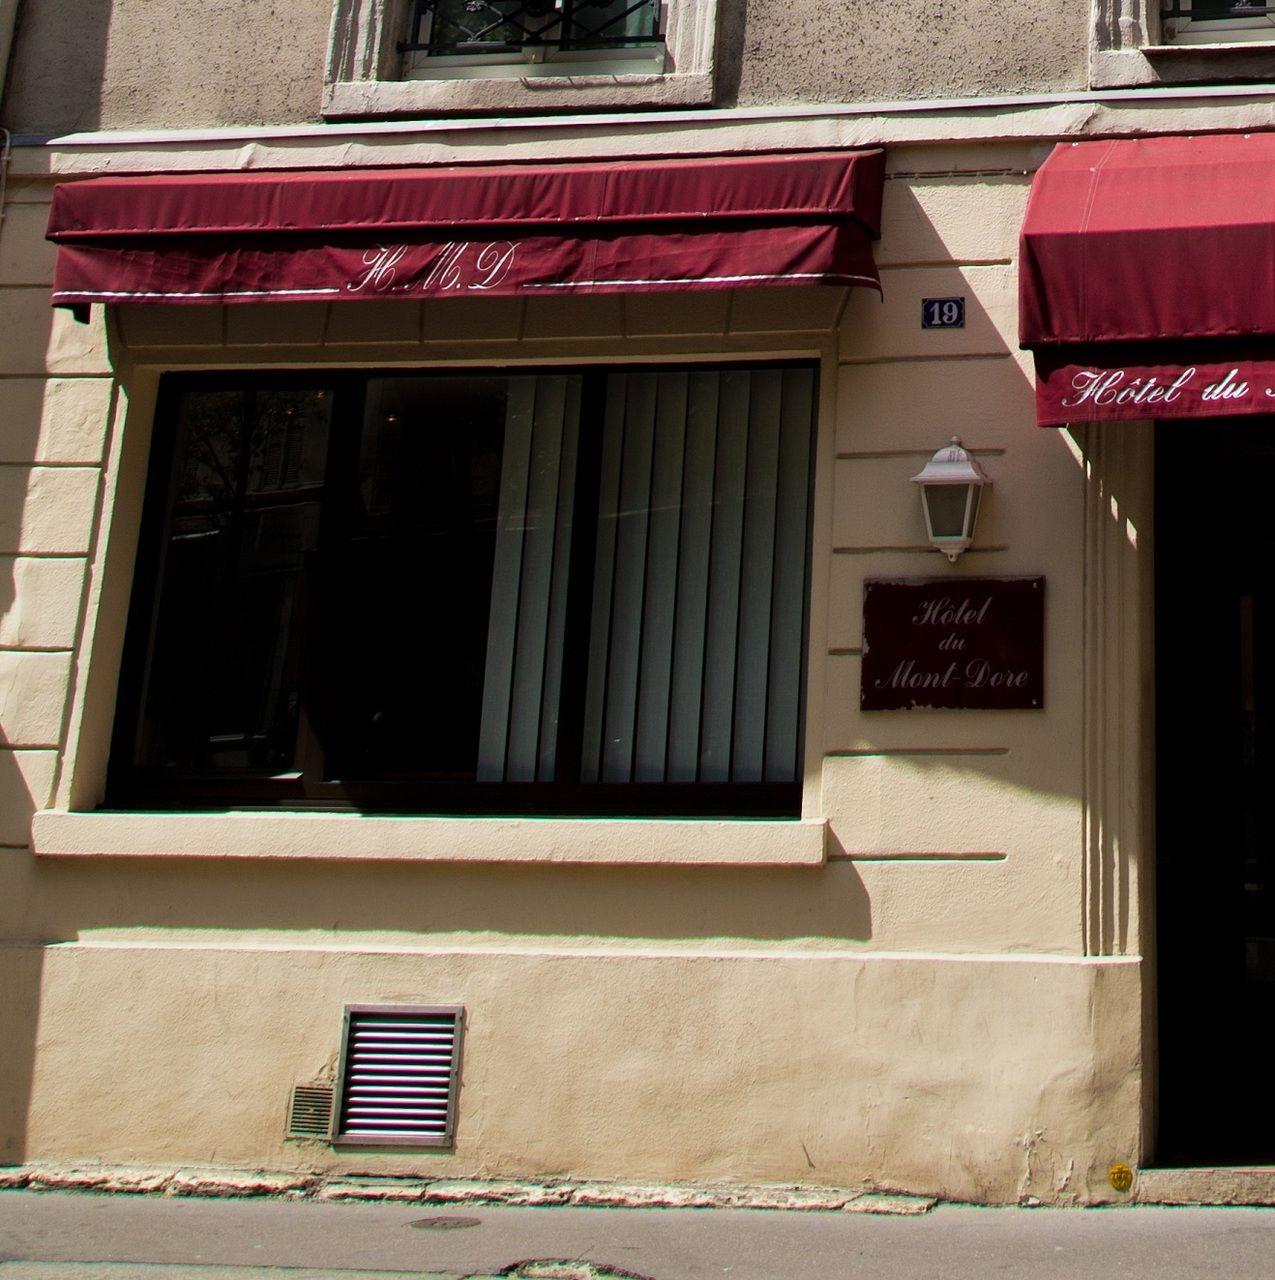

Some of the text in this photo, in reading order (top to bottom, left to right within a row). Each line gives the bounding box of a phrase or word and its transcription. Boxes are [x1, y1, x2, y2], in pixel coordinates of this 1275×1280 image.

[929, 301, 959, 325] 19
[1061, 367, 1196, 407] Hôtel
[1201, 368, 1249, 401] du
[911, 596, 993, 626] Hôtel
[938, 632, 966, 651] du
[874, 657, 1029, 689] Mont-Dore
